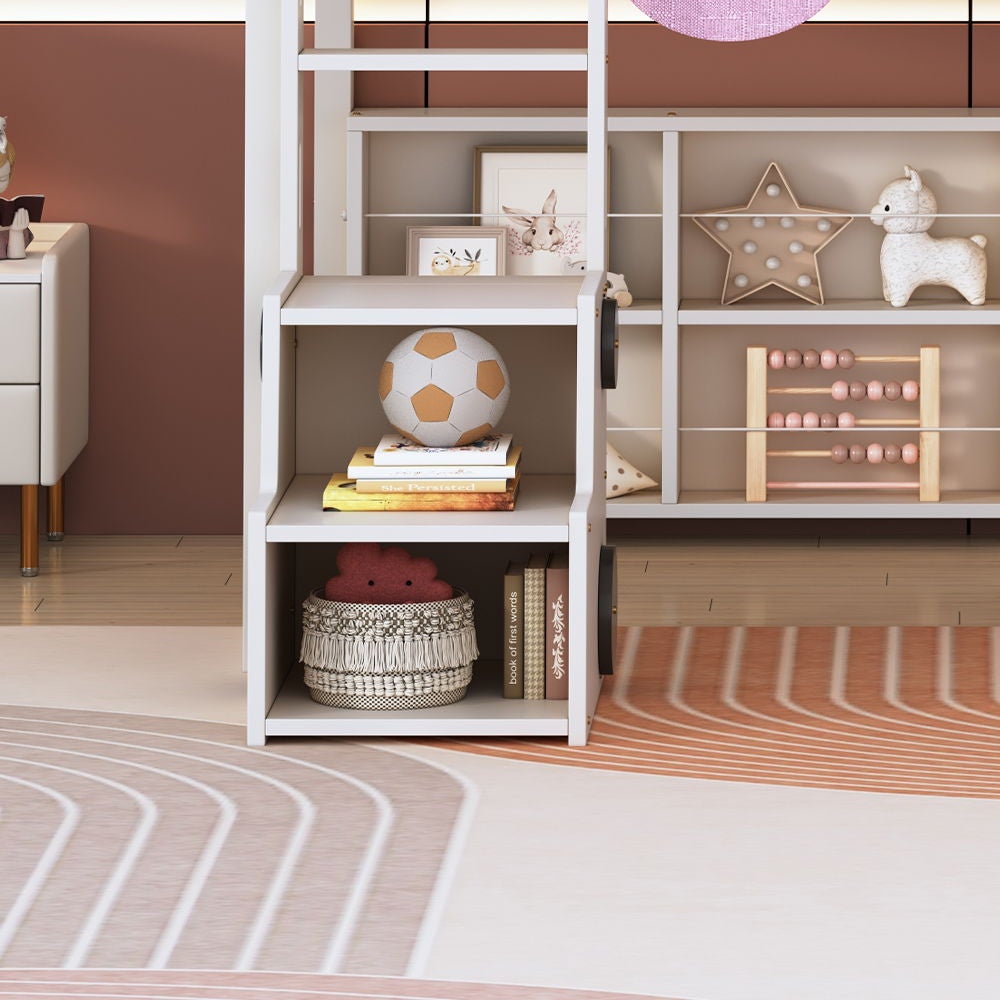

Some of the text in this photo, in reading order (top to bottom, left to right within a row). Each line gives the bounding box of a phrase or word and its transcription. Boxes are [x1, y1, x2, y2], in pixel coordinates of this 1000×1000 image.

[509, 591, 517, 685] book of first words
